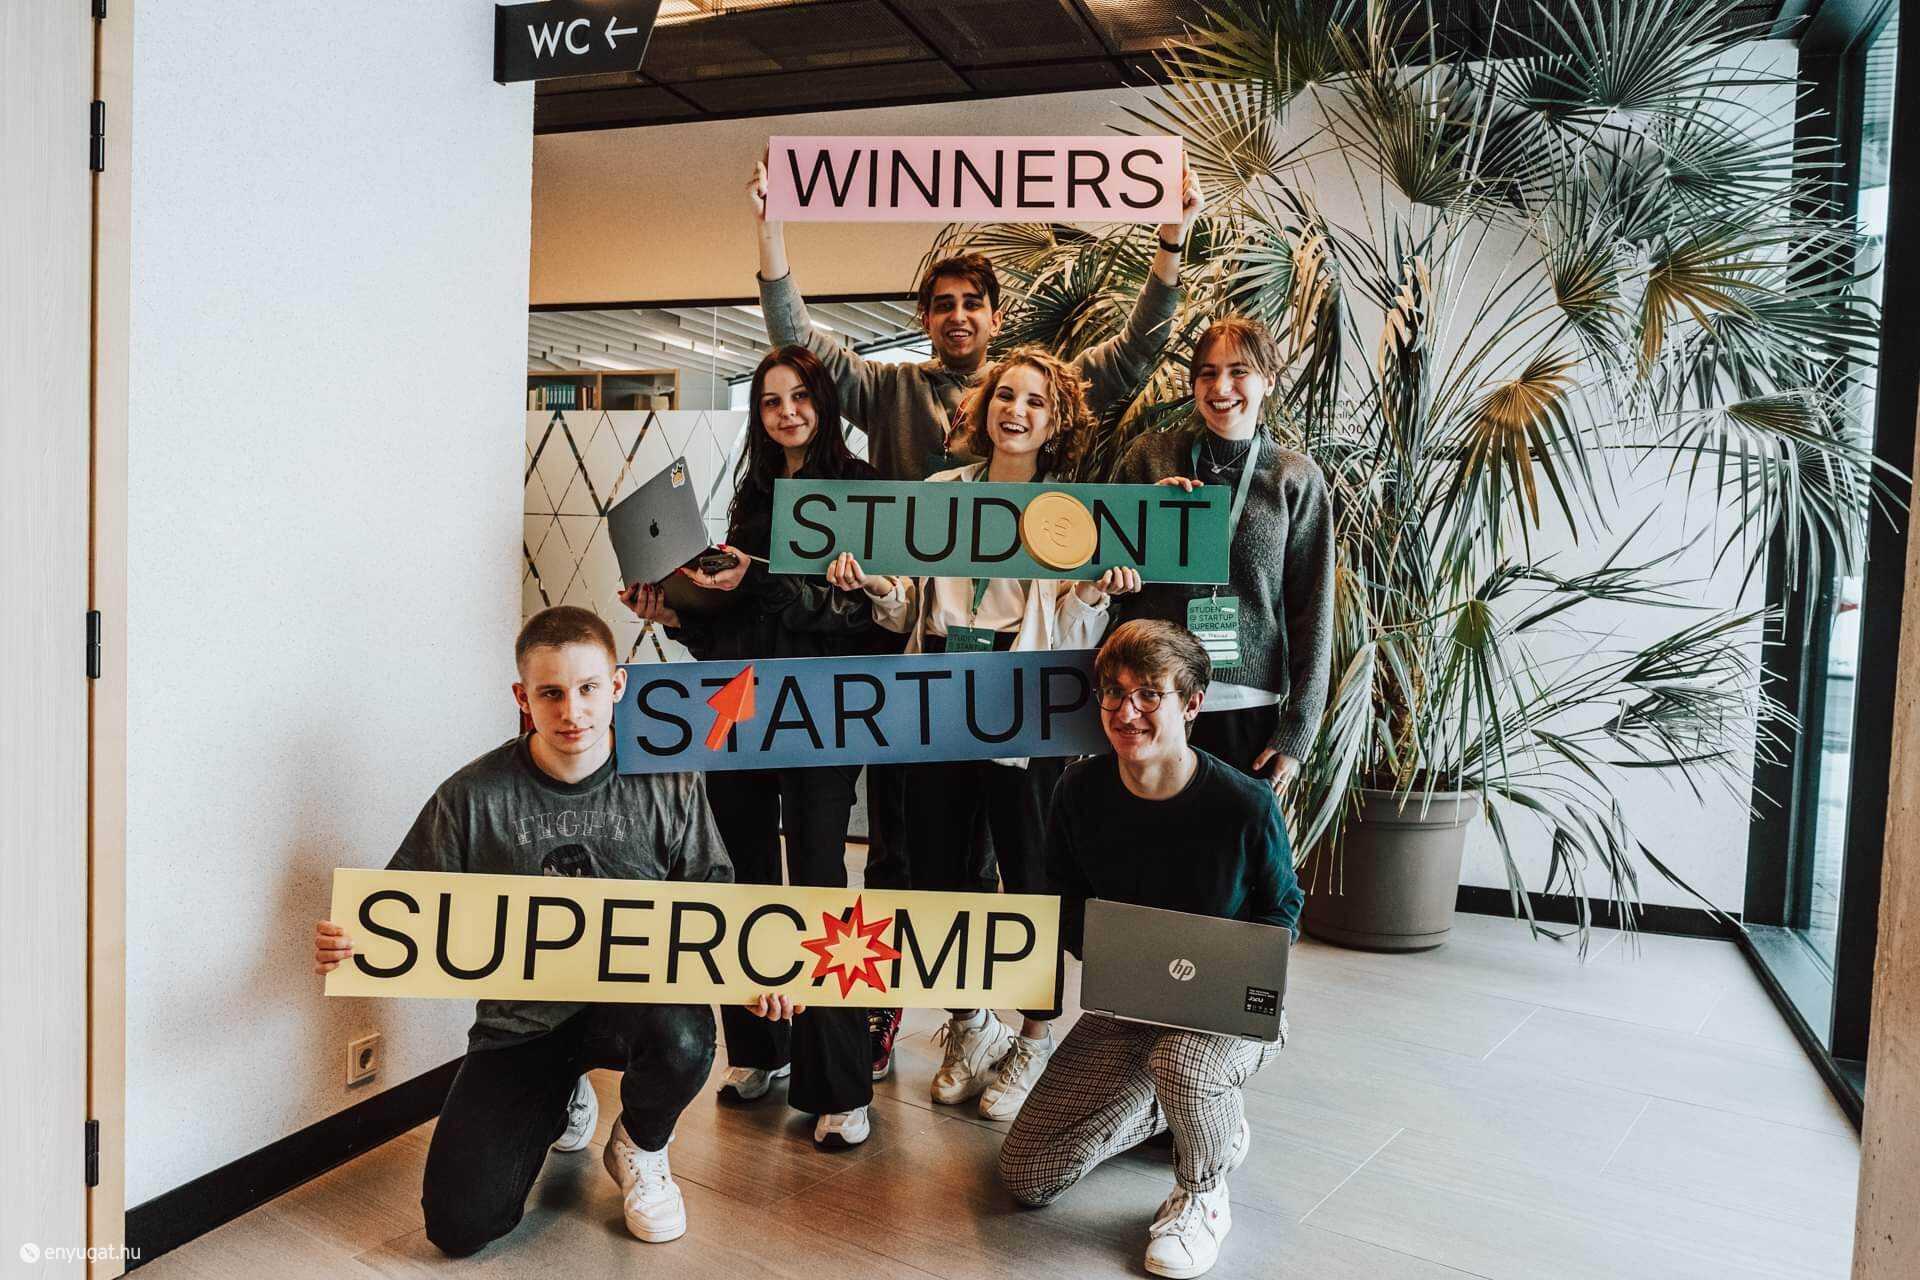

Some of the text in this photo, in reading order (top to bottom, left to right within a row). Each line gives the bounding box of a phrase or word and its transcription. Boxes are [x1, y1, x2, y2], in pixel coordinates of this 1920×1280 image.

[527, 18, 591, 59] WC
[786, 149, 1164, 209] WINNERS
[789, 493, 1212, 568] STUDNT
[1190, 622, 1238, 630] SUPERCAMP
[353, 890, 1037, 990] SUPERCMP
[1171, 959, 1194, 980] hp
